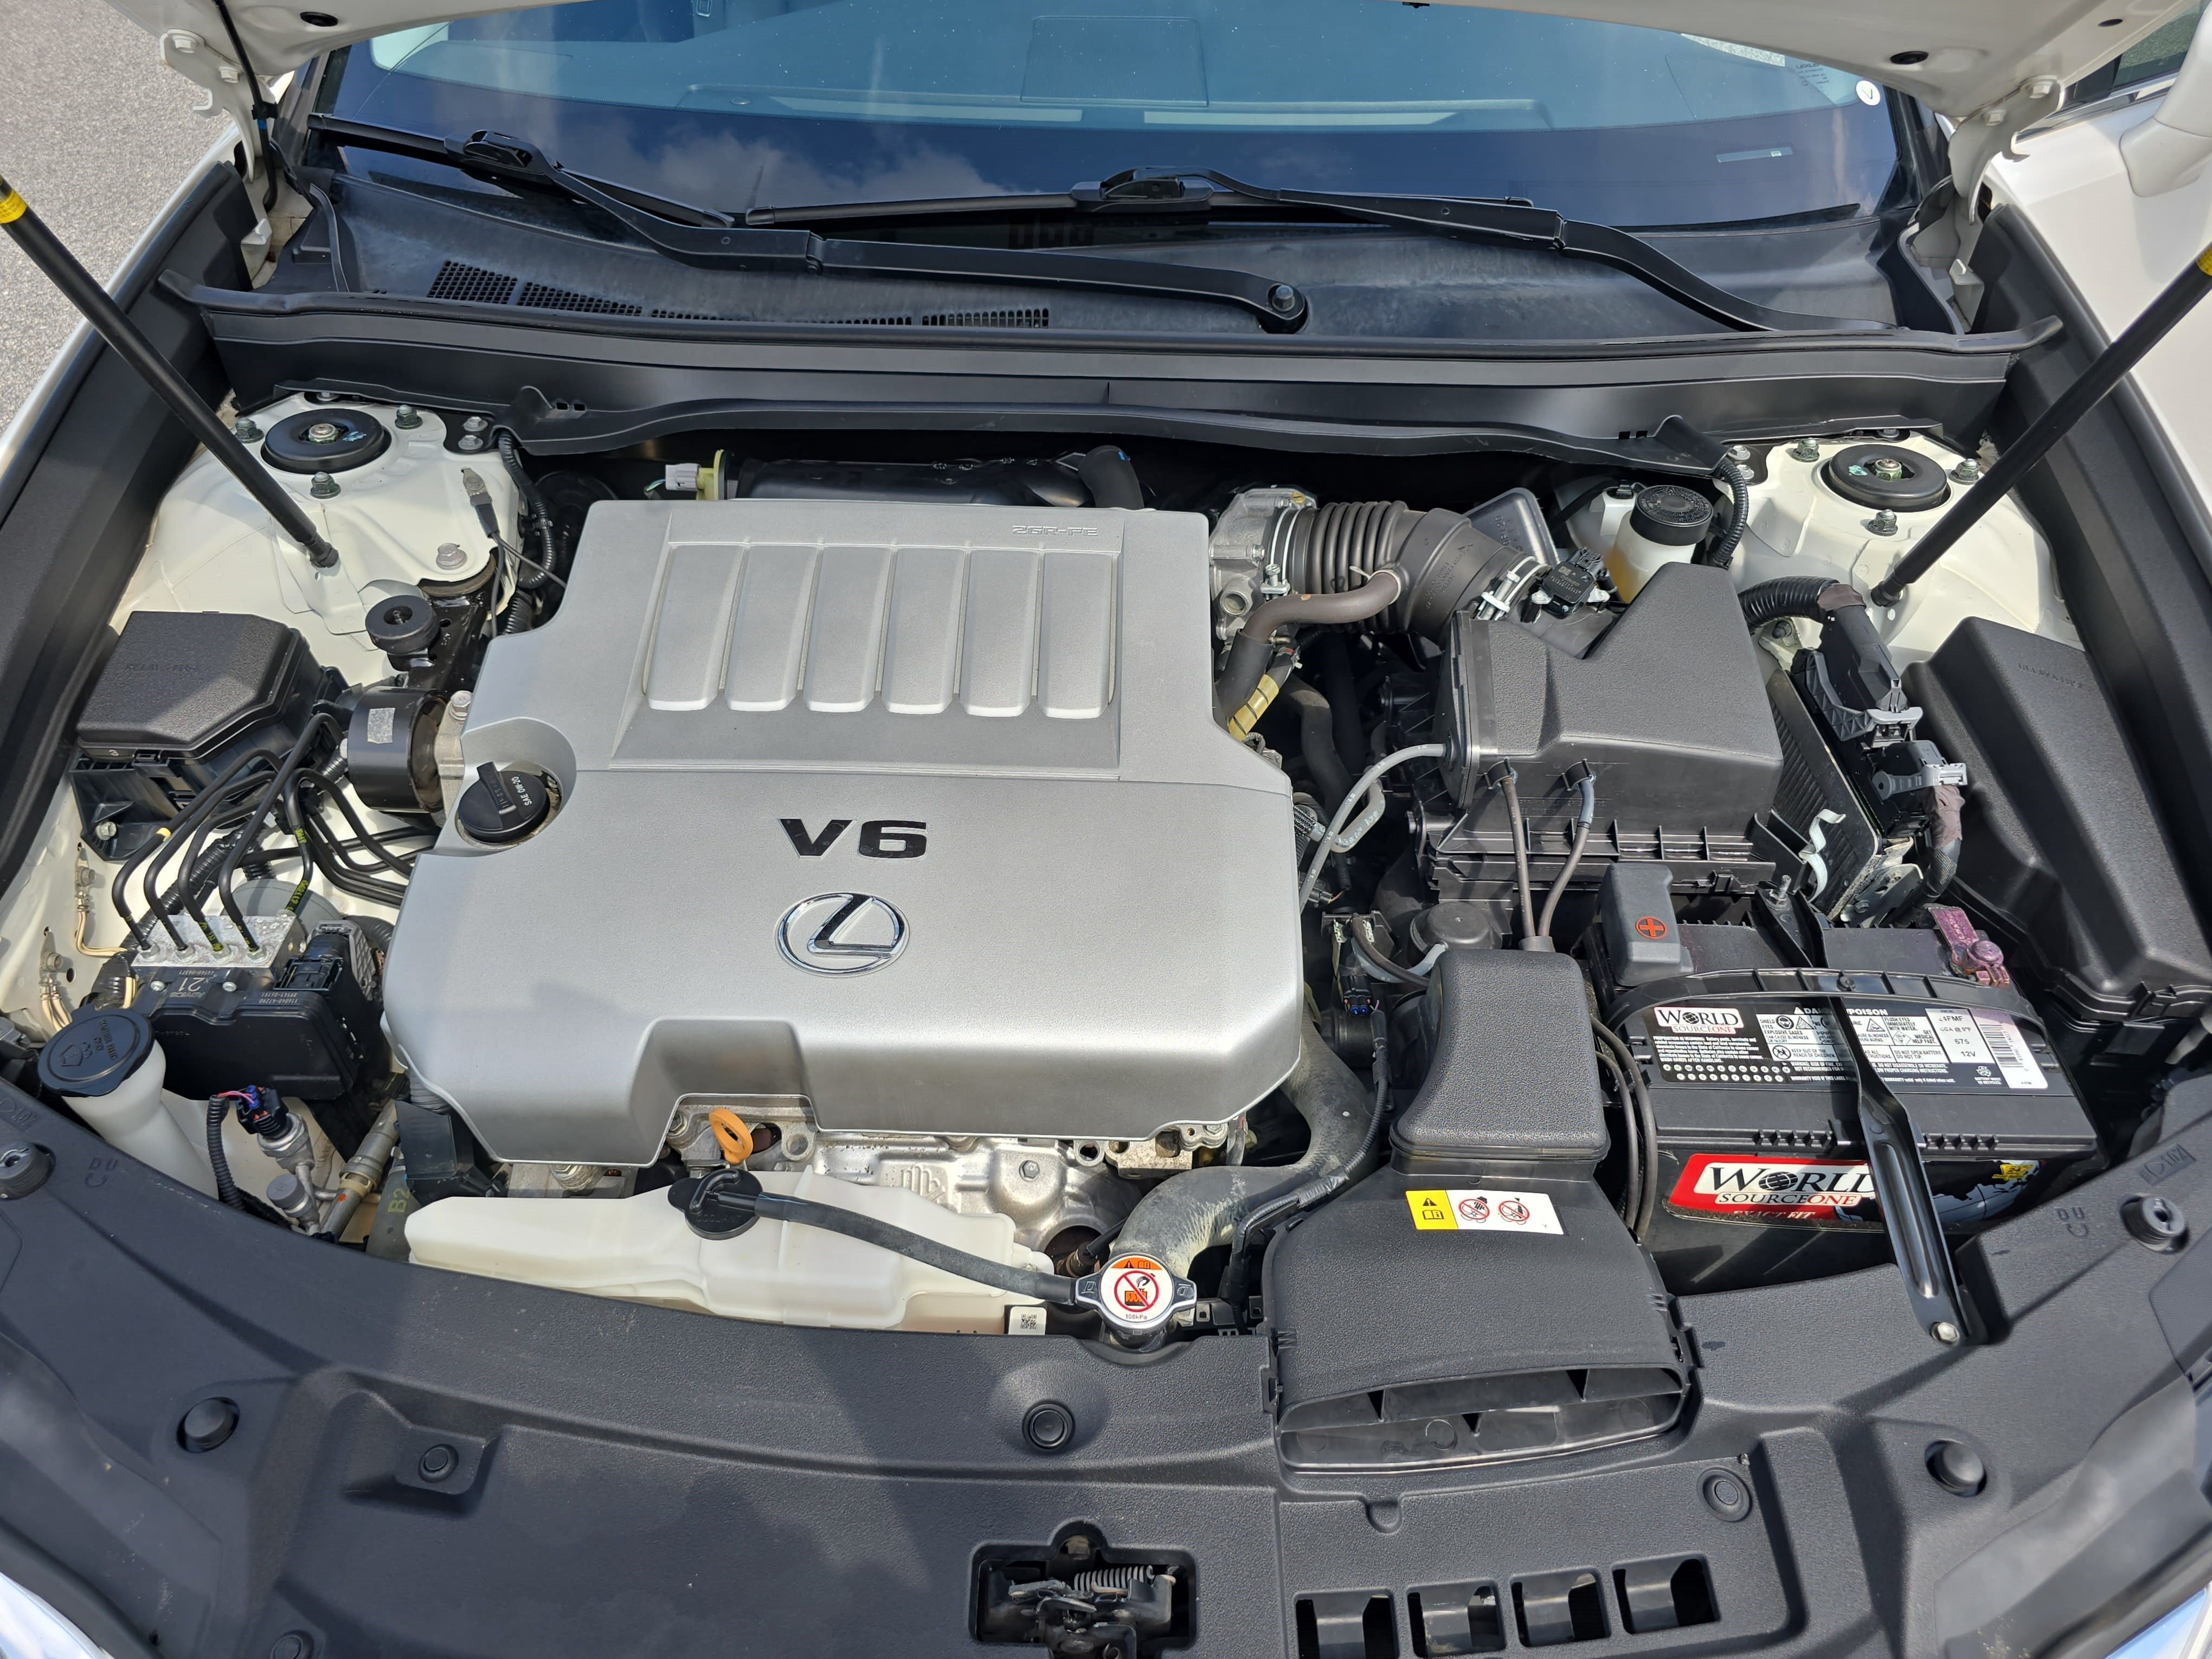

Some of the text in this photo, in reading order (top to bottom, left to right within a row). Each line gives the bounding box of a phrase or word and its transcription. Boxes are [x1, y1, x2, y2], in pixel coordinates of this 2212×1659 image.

[1012, 525, 1098, 537] 2GR-FE
[511, 776, 532, 806] SAE 0W-20
[777, 818, 928, 860] V6
[1657, 1009, 1739, 1025] WORLD
[1674, 1025, 1734, 1033] SOURCEONE
[1719, 1193, 1859, 1205] SOURCEONE
